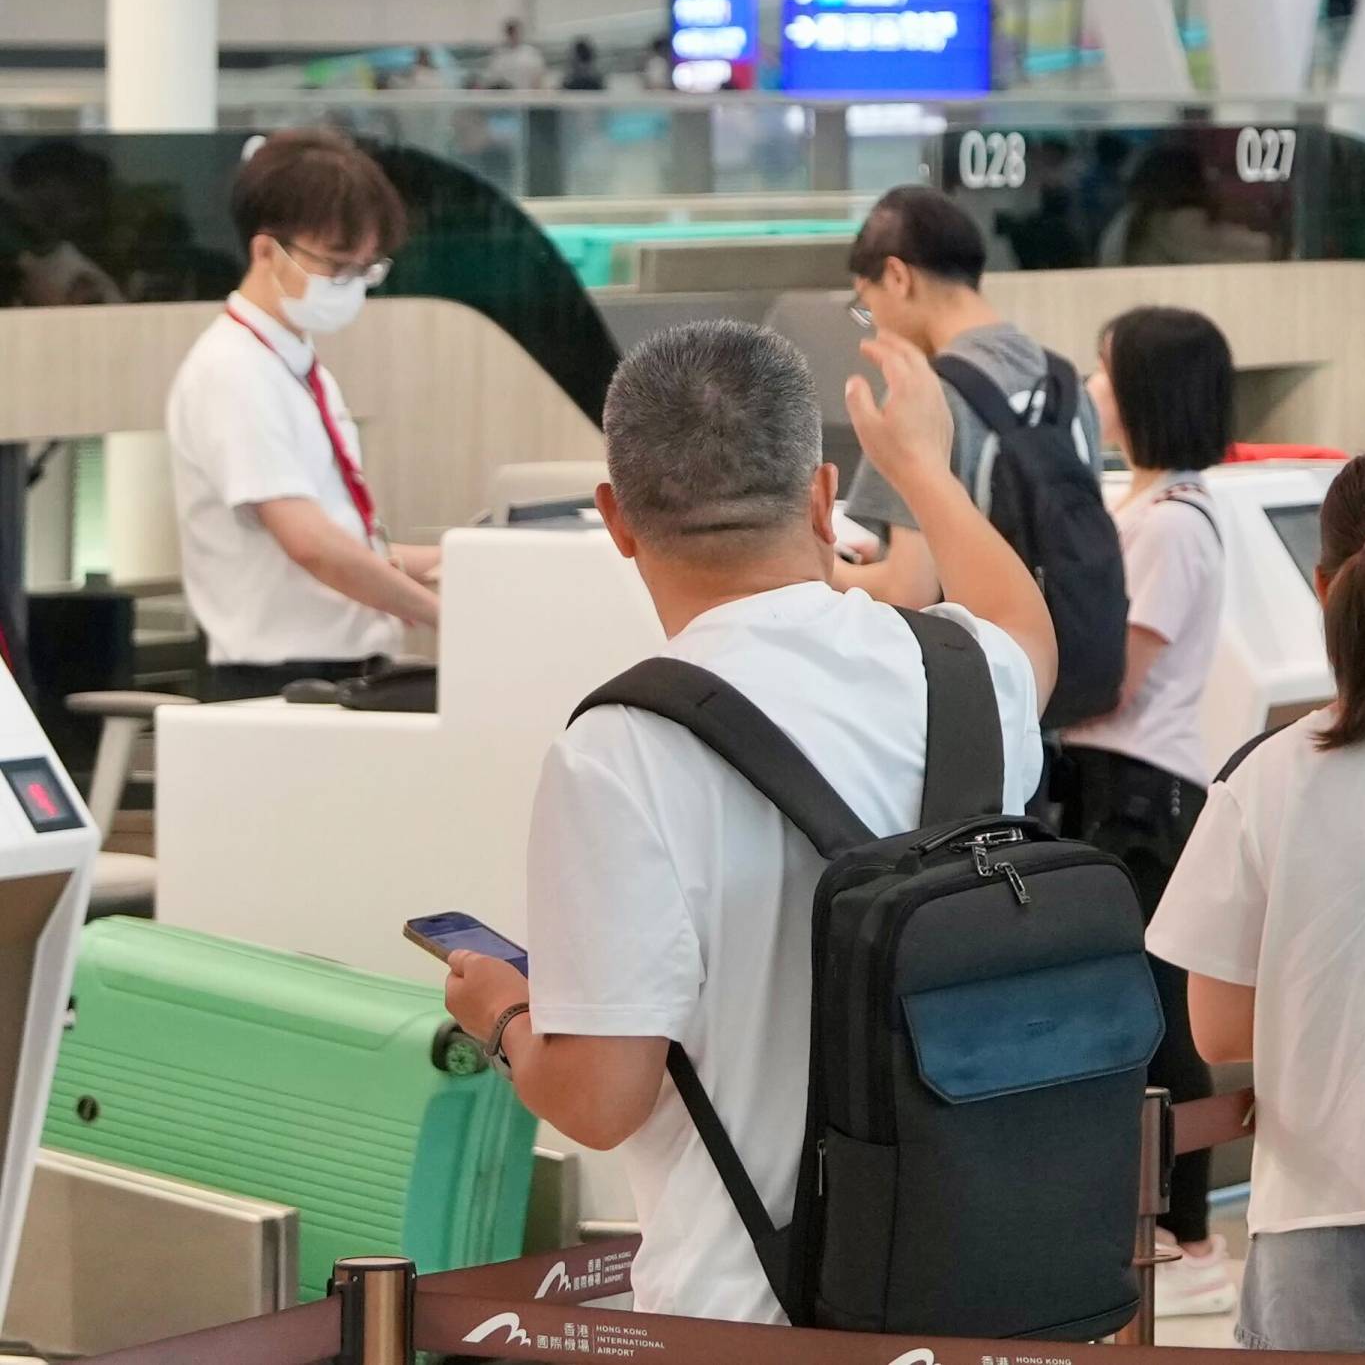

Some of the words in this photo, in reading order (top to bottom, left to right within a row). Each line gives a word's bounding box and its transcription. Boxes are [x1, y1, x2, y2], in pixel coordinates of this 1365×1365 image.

[958, 129, 1027, 189] 028
[1236, 126, 1296, 183] 027
[564, 1322, 589, 1338] 香港
[596, 1324, 621, 1334] HONG
[623, 1327, 648, 1336] KONG
[536, 1334, 590, 1353] 國際機場
[597, 1336, 665, 1349] INTERNATIONAL
[597, 1346, 635, 1357] AIRPORT
[1016, 1356, 1043, 1365] HONG
